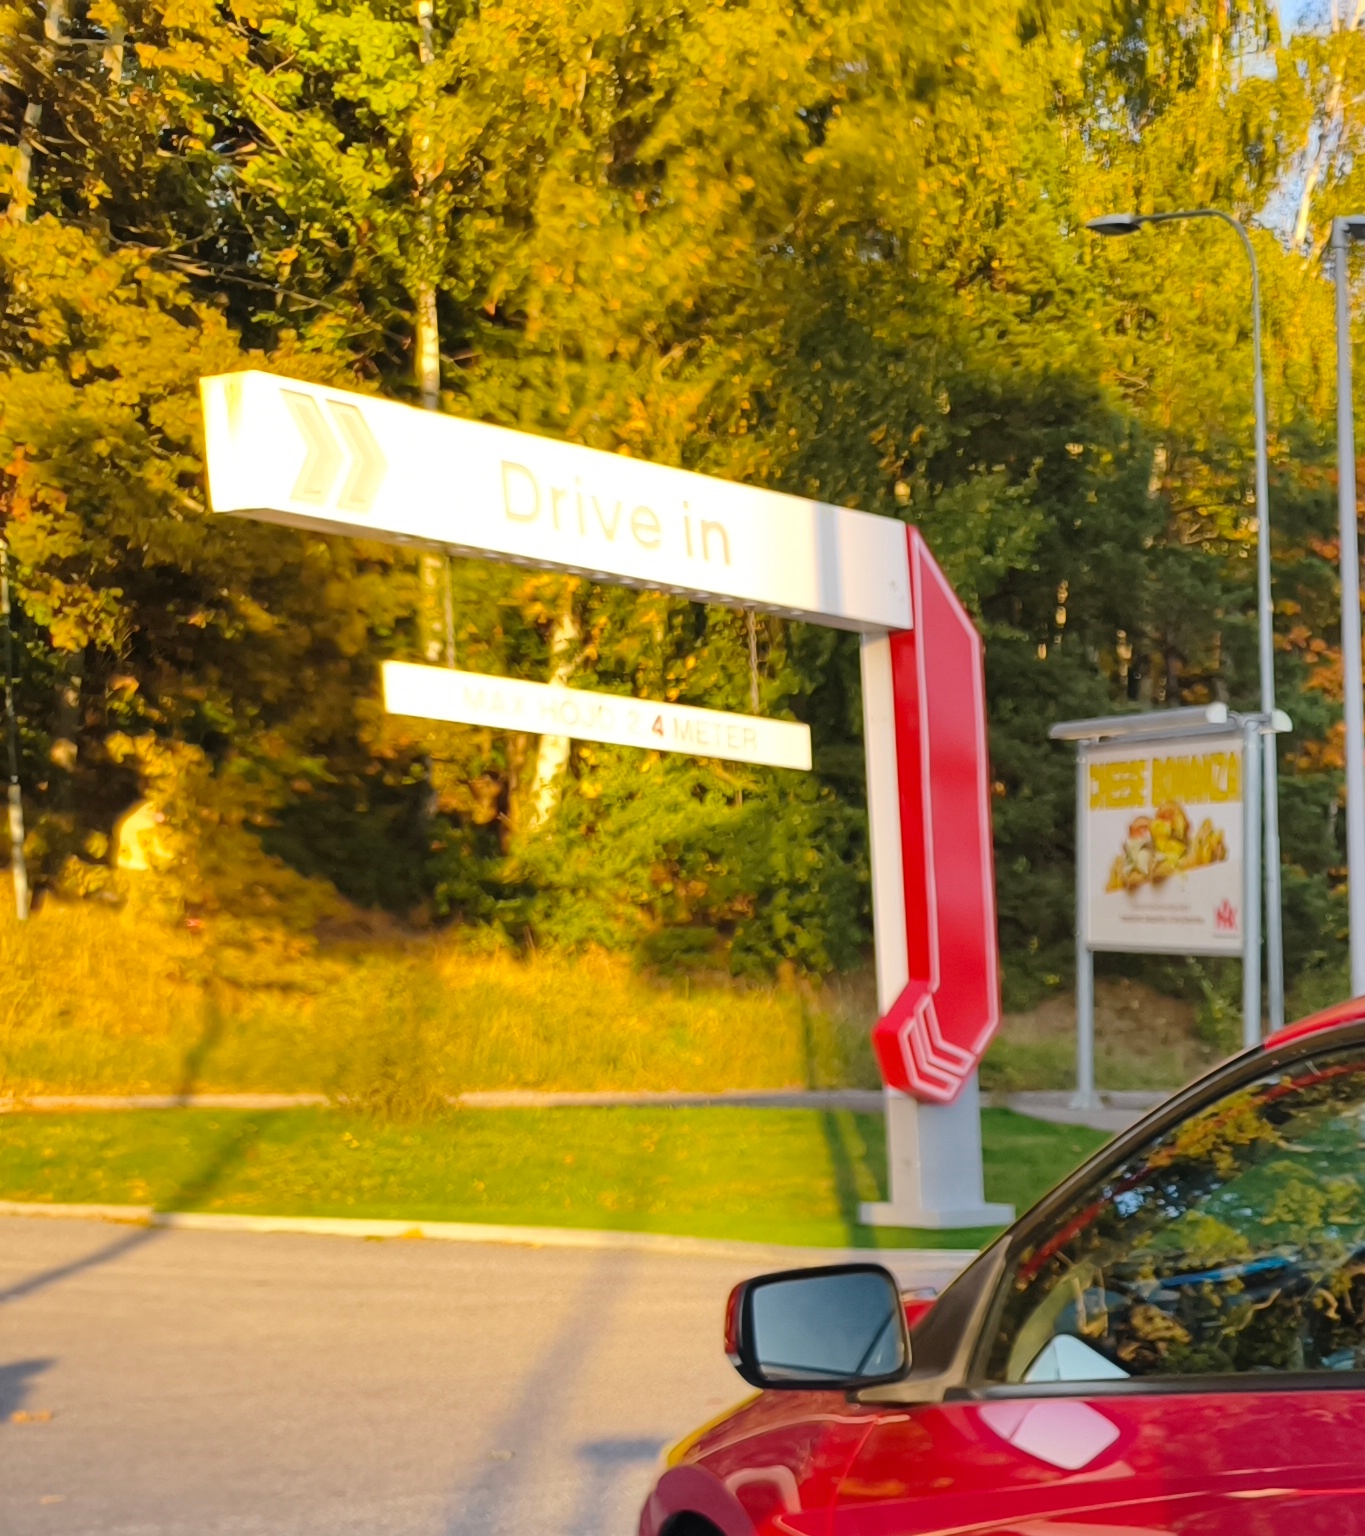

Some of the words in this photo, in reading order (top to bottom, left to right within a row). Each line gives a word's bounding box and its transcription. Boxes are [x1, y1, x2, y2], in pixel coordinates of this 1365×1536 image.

[500, 459, 662, 548] Drive
[683, 500, 731, 566] in
[672, 717, 758, 751] METER
